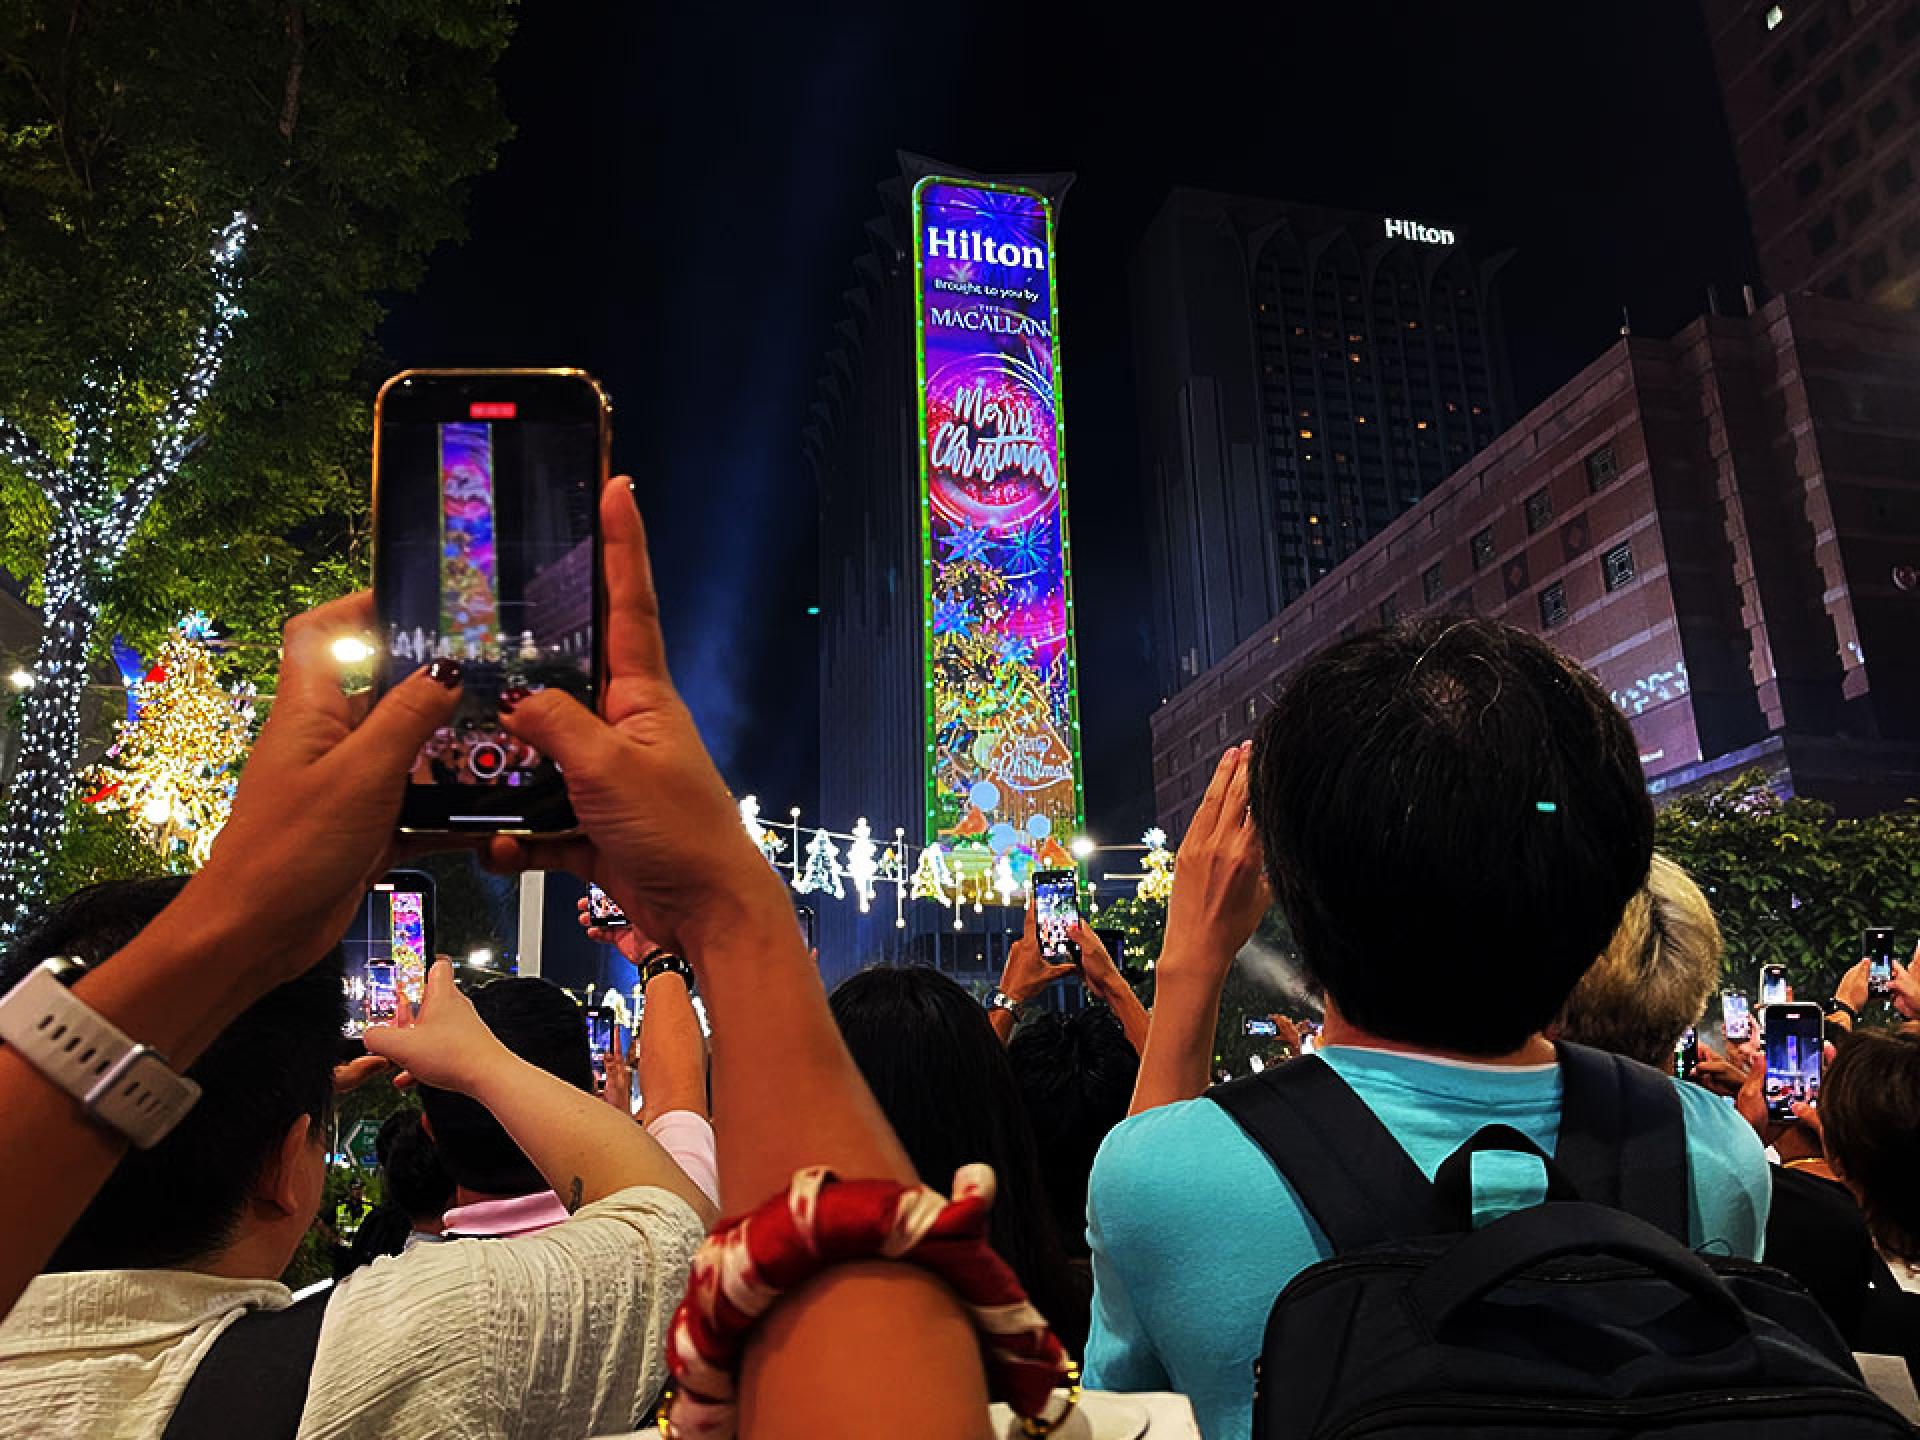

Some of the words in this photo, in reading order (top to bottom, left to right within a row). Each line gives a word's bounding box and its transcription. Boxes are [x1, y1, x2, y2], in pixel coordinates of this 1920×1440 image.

[928, 227, 1044, 270] Hilton
[1384, 218, 1454, 244] Hilton
[935, 279, 982, 295] Brought
[984, 285, 998, 297] to
[1000, 289, 1022, 299] you
[1024, 289, 1039, 303] by
[930, 307, 1052, 337] MACALLAN
[954, 386, 1034, 439] Merry
[932, 421, 1055, 487] Christmas
